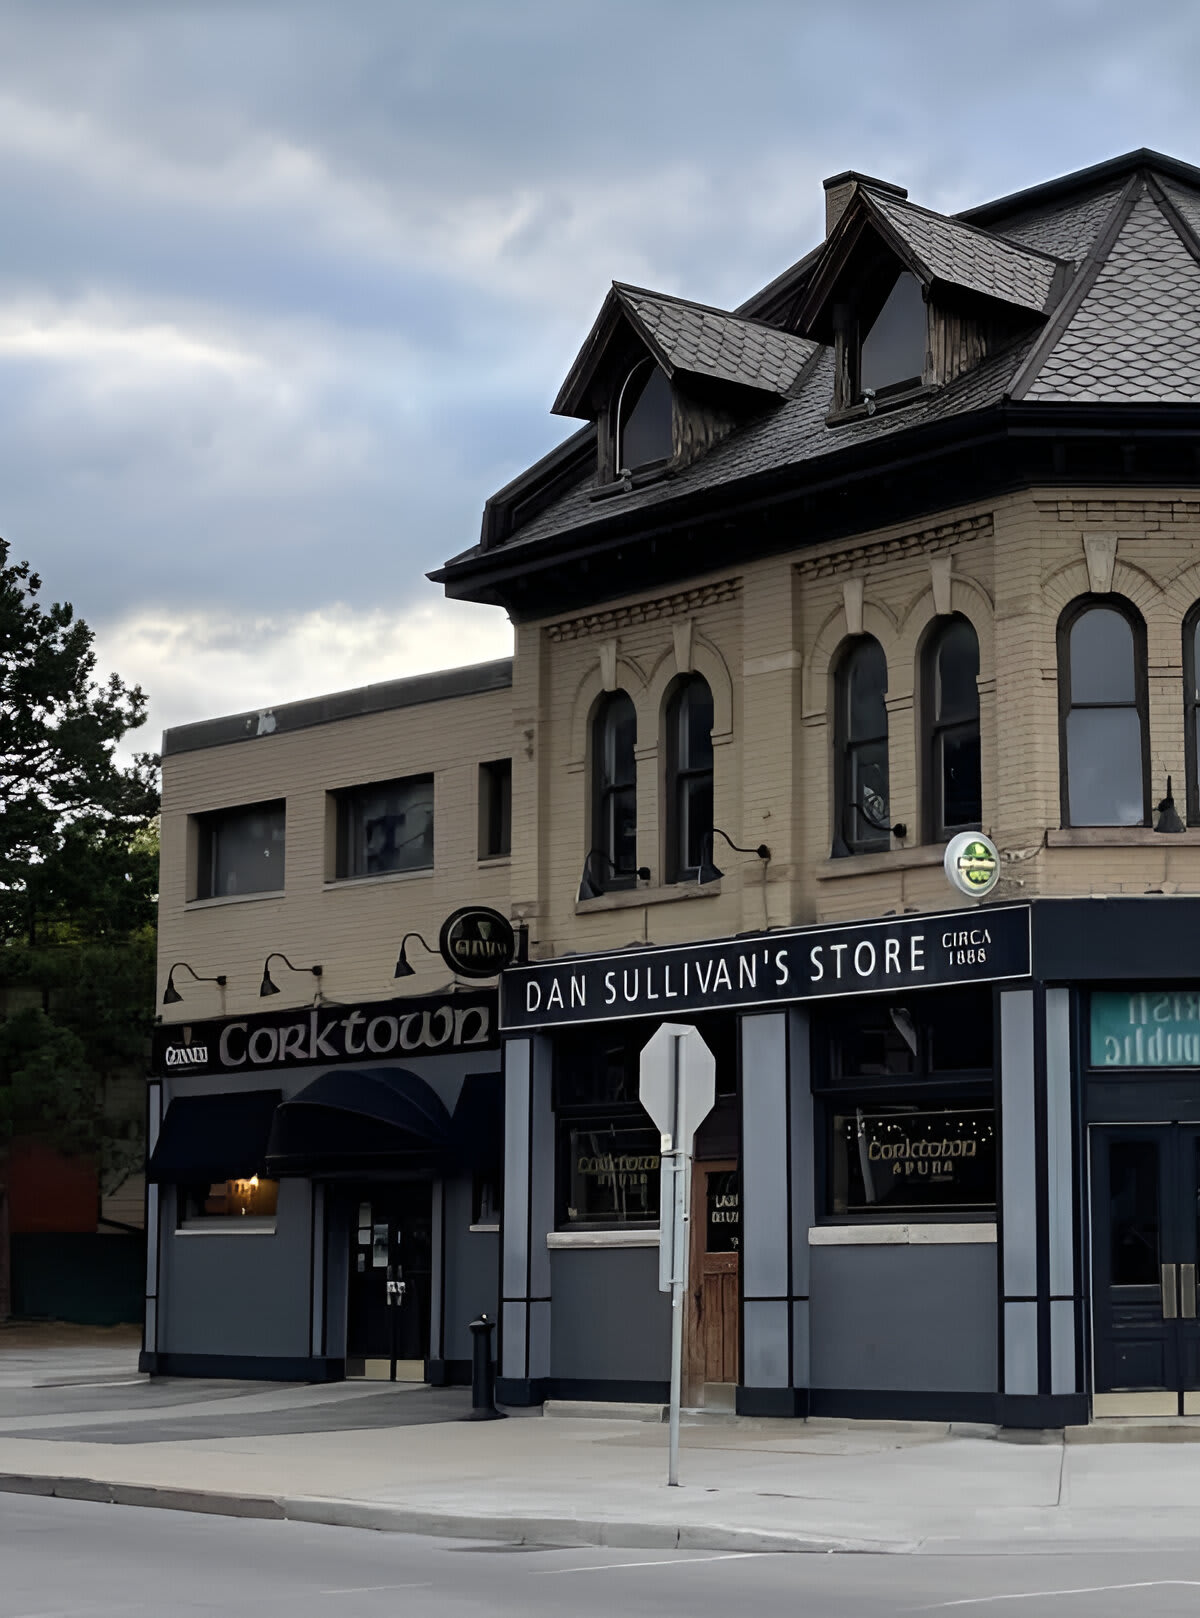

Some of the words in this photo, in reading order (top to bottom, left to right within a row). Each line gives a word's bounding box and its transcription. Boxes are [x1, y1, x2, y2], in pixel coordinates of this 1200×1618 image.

[942, 929, 991, 948] CIRCA
[949, 948, 986, 966] 1888
[526, 975, 587, 1012] DAN
[604, 949, 789, 1004] SULLIVAN'S
[810, 934, 925, 982] STORE
